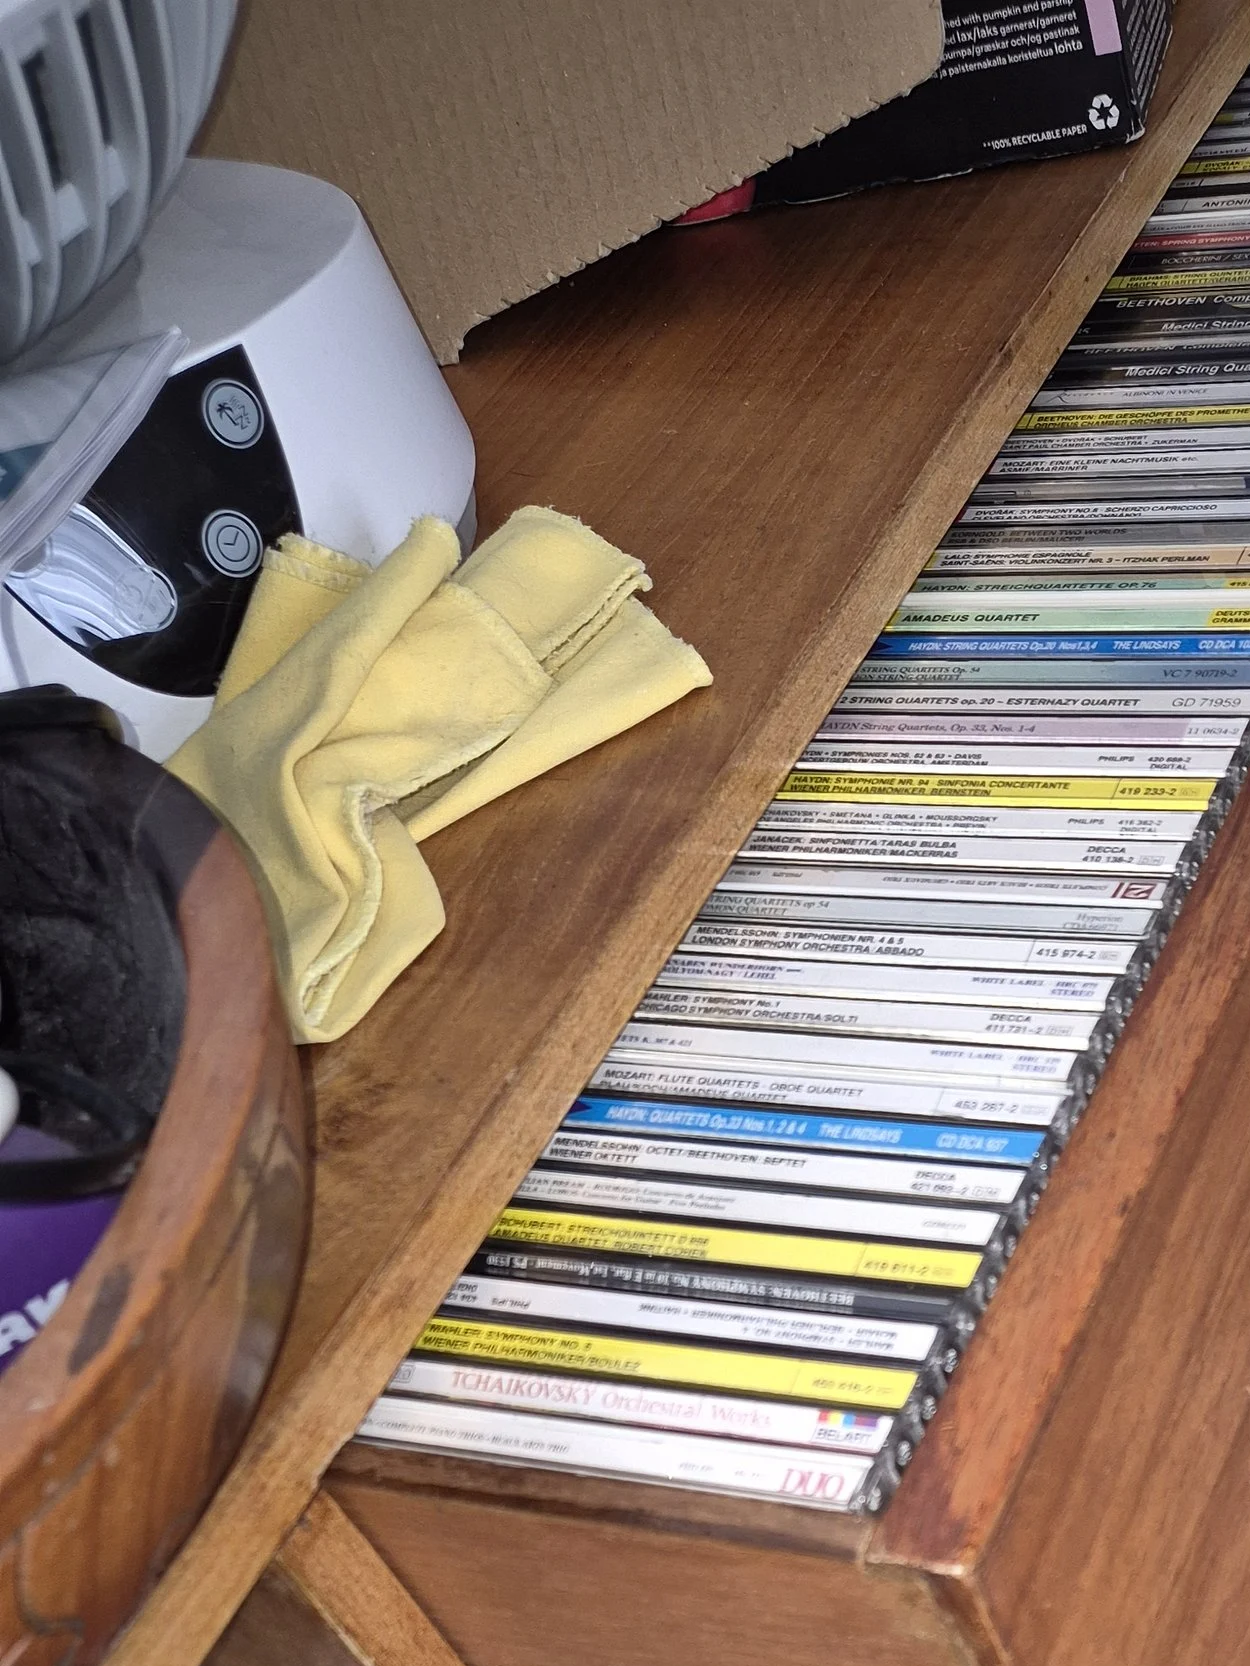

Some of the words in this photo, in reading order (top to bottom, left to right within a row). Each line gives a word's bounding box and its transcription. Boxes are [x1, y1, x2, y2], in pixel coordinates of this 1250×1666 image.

[962, 14, 982, 25] with
[982, 8, 1022, 24] pumpkin
[1023, 2, 1040, 13] and
[956, 21, 998, 43] lax/laks
[1000, 11, 1077, 36] garnerat/garneret
[1010, 34, 1042, 47] och/og
[1043, 25, 1080, 42] pastinak
[1008, 49, 1053, 69] koristeltua
[1053, 40, 1083, 55] lohta
[1012, 129, 1061, 146] RECYCLABLE
[1062, 124, 1088, 137] PAPER
[1161, 255, 1222, 265] BOCCHERINI
[1116, 296, 1207, 309] BEETHOVEN
[1160, 320, 1208, 332] Medici
[1125, 367, 1171, 378] Medici
[1174, 365, 1220, 377] String
[1037, 414, 1095, 422] BEETHOVEN:
[1115, 410, 1173, 419] GESCHÖPFE
[1034, 422, 1081, 430] ORPHEUS
[1130, 417, 1188, 425] ORCHESTRA
[1002, 459, 1046, 467] MOZART:
[1074, 457, 1109, 465] KLEINE
[1110, 456, 1179, 464] NACHTMUSIK
[1009, 529, 1056, 537] BETWEEN
[1084, 528, 1127, 536] WORLDS
[1033, 551, 1093, 559] ESPAGNOLE
[1161, 555, 1210, 563] PERLMAN
[921, 584, 971, 592] HAYDN:
[974, 583, 1114, 591] STREICHQUARTETTE
[902, 614, 969, 622] AMADEUS
[974, 613, 1040, 622] QUARTET
[944, 642, 978, 651] STRING
[978, 641, 1029, 651] QUARTETS
[1113, 641, 1129, 649] THE
[1132, 641, 1181, 649] LINDSAYS
[1198, 640, 1214, 649] CD
[1214, 640, 1235, 649] DCA
[1164, 669, 1183, 678] VC
[849, 697, 892, 705] STRING
[895, 697, 959, 705] QUARTETS
[1081, 699, 1141, 707] QUARTET
[1171, 698, 1195, 708] GD
[1199, 698, 1242, 708] 71959
[860, 722, 895, 732] String
[835, 776, 896, 786] SYMPHONIE
[937, 779, 986, 788] SINFONIA
[989, 780, 1071, 790] CONCERTANTE
[930, 787, 992, 797] BERNSTEIN
[1119, 787, 1141, 795] 419
[1087, 846, 1126, 854] DECCA
[783, 930, 856, 943] SYMPHONIEN
[692, 935, 738, 947] LONDON
[738, 939, 800, 950] SYMPHONY
[1036, 948, 1058, 957] 415
[989, 1013, 1032, 1023] DECCA
[659, 1074, 694, 1085] FLUTE
[697, 1077, 759, 1090] QUARTETS
[451, 1371, 596, 1405] TCHAIKOVSKY
[602, 1385, 703, 1417] Orchestral
[711, 1396, 773, 1427] Works
[816, 1428, 873, 1445] BELART
[779, 1466, 846, 1498] DUO
